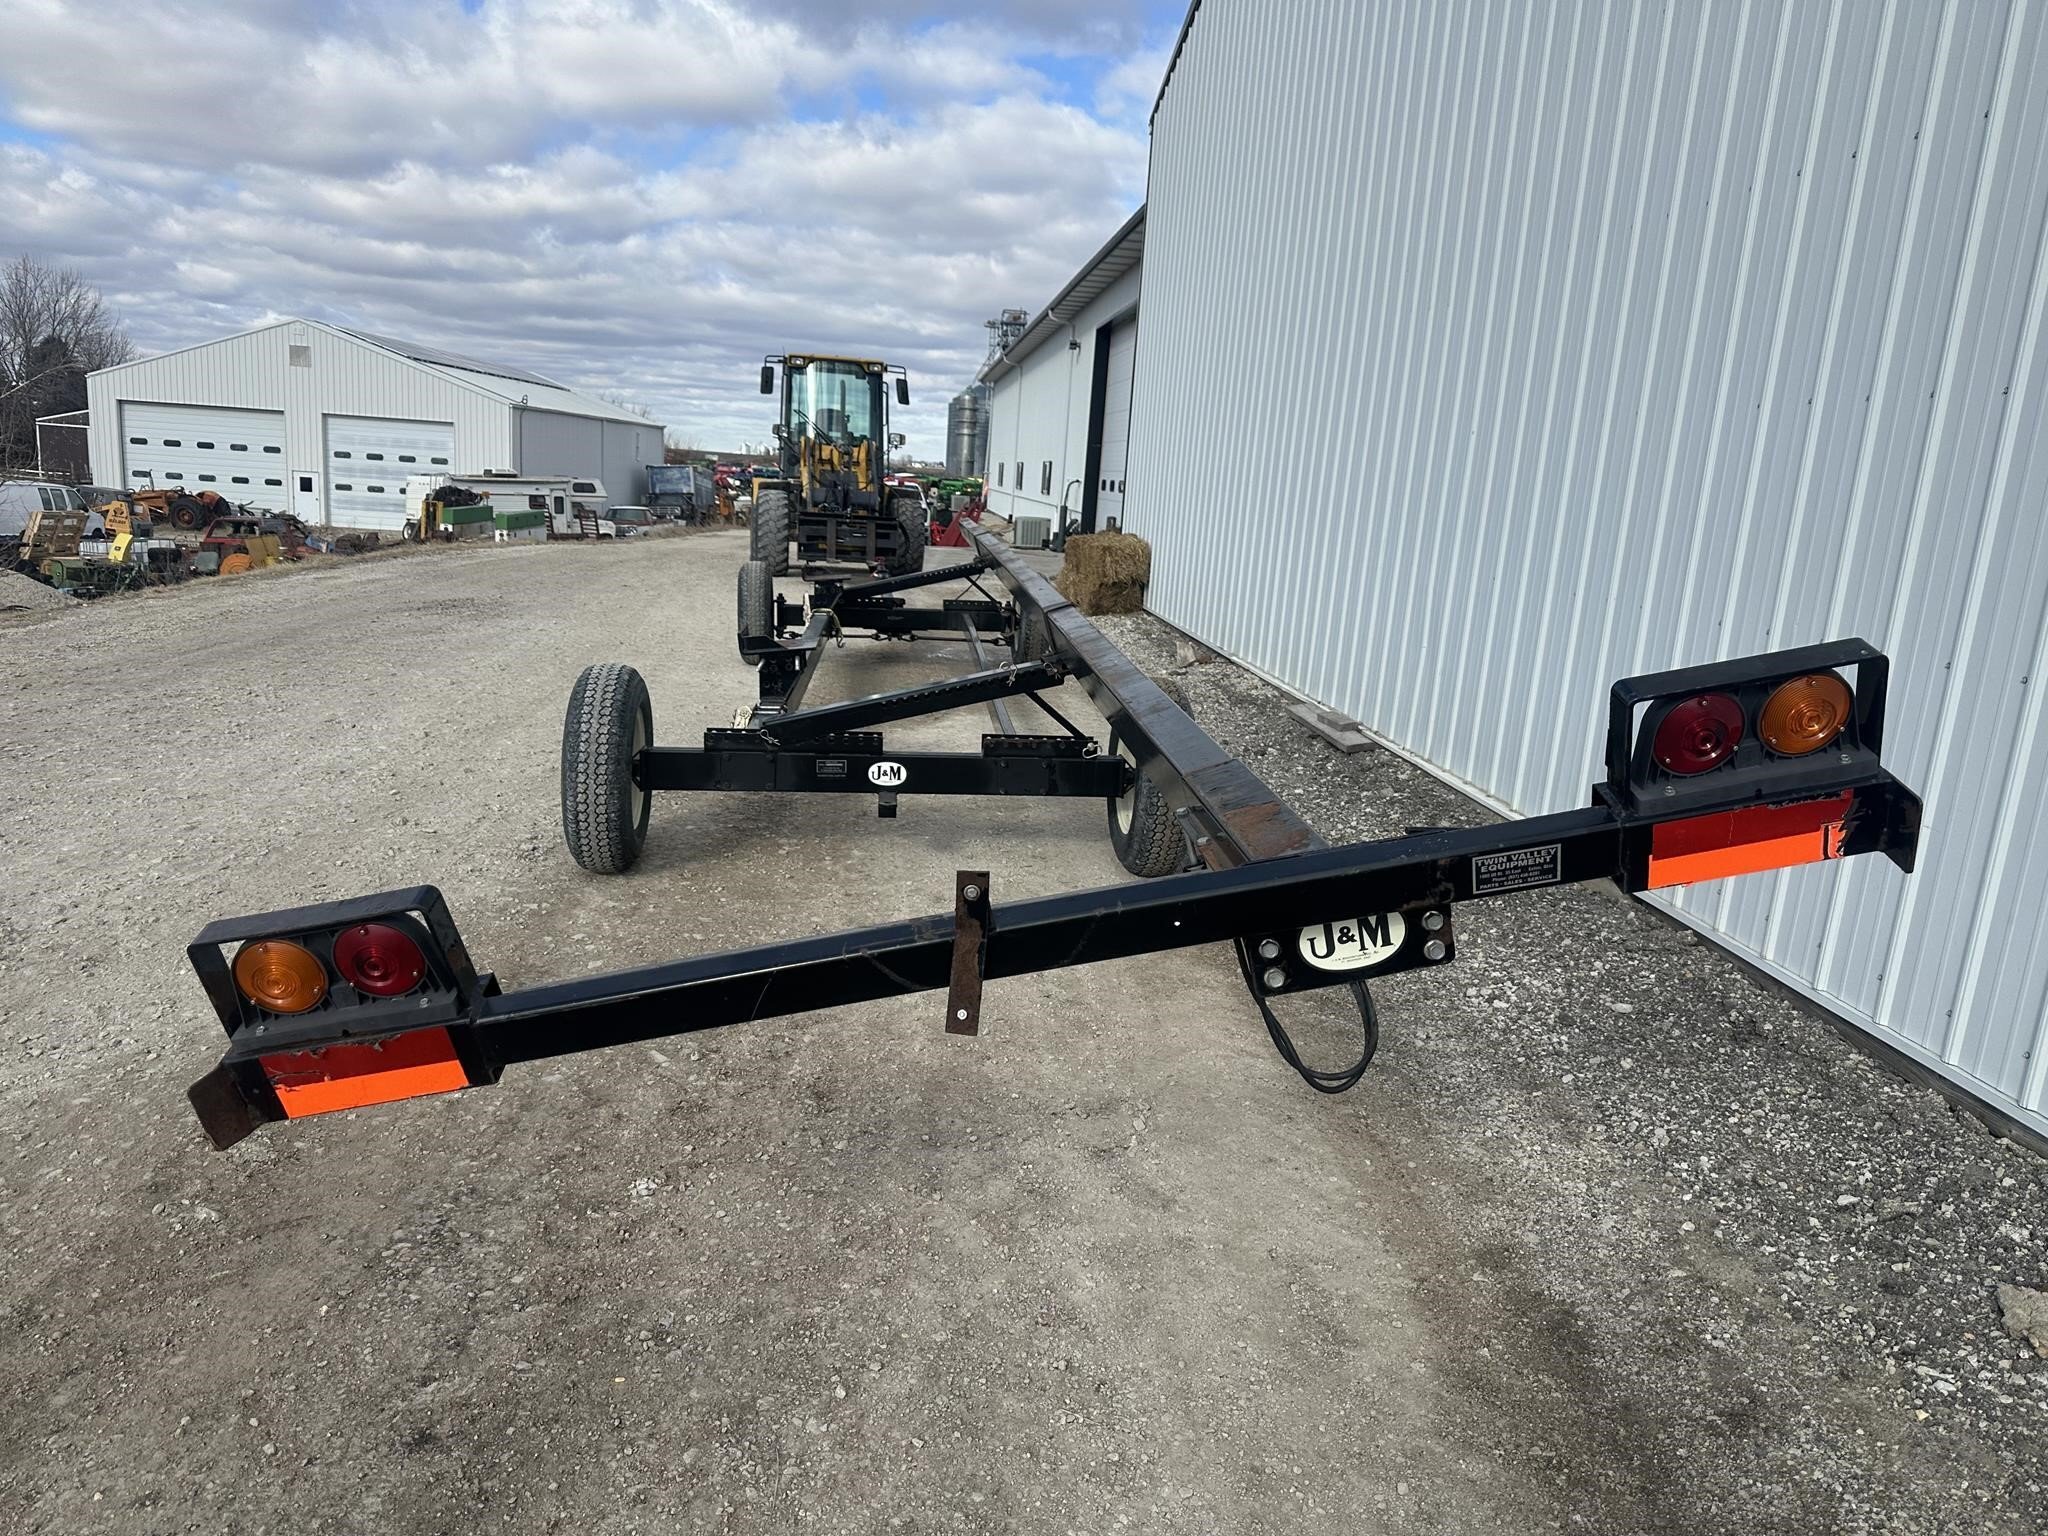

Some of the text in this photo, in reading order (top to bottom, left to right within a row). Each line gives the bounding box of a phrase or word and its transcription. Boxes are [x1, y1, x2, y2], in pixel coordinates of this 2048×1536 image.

[872, 765, 902, 781] J&M
[1476, 848, 1557, 866] TWIN VALLEY
[1480, 855, 1552, 873] EQUIPMENT
[1527, 874, 1553, 882] SERVICE
[1307, 913, 1394, 959] J&M
